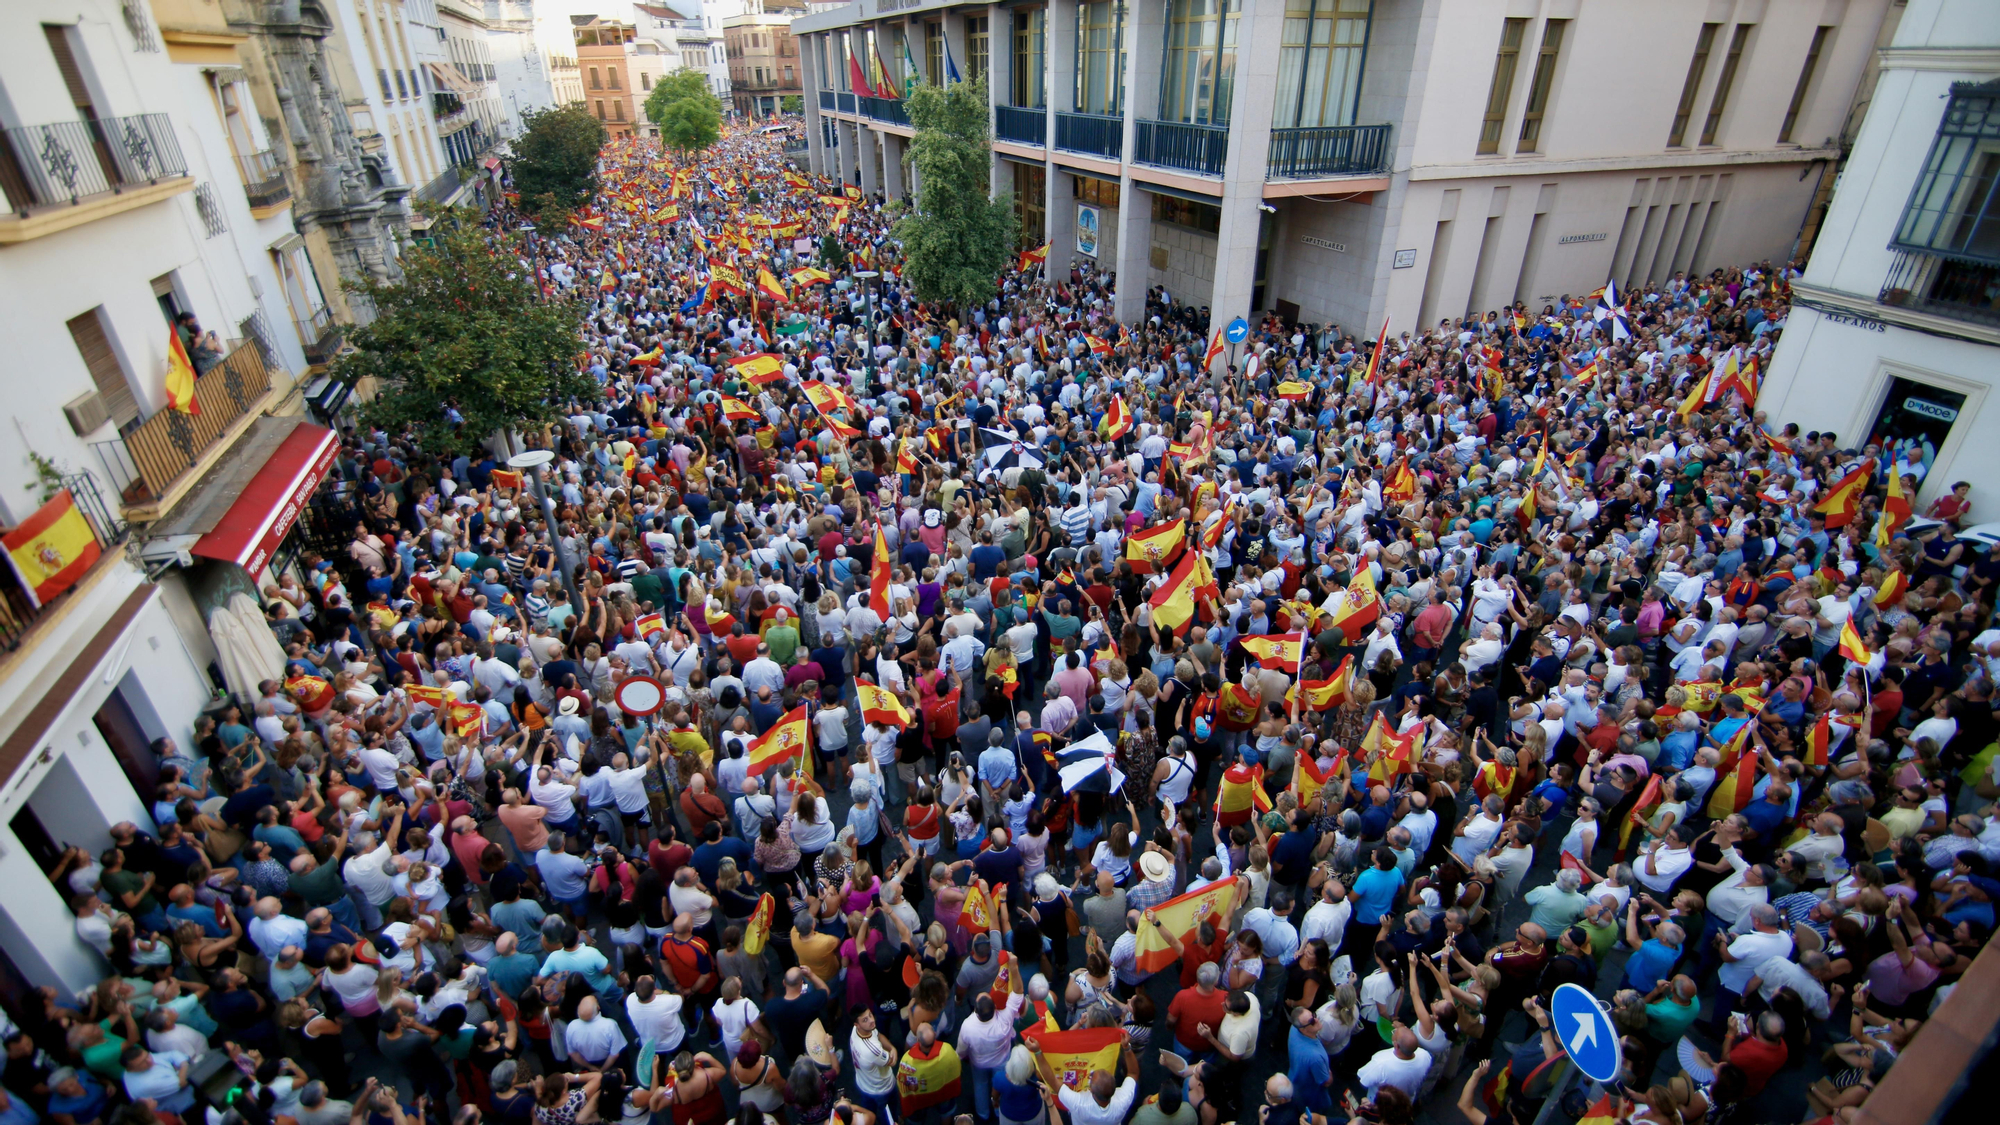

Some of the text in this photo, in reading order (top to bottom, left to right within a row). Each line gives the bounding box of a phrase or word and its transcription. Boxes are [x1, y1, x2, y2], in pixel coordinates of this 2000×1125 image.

[1301, 235, 1344, 251] CAPITULARES
[1561, 234, 1589, 242] ALFONSO
[1825, 313, 1886, 333] ALFAROS
[275, 502, 298, 537] CAFETERÍA
[296, 487, 306, 506] SAN
[303, 472, 318, 495] PABLO
